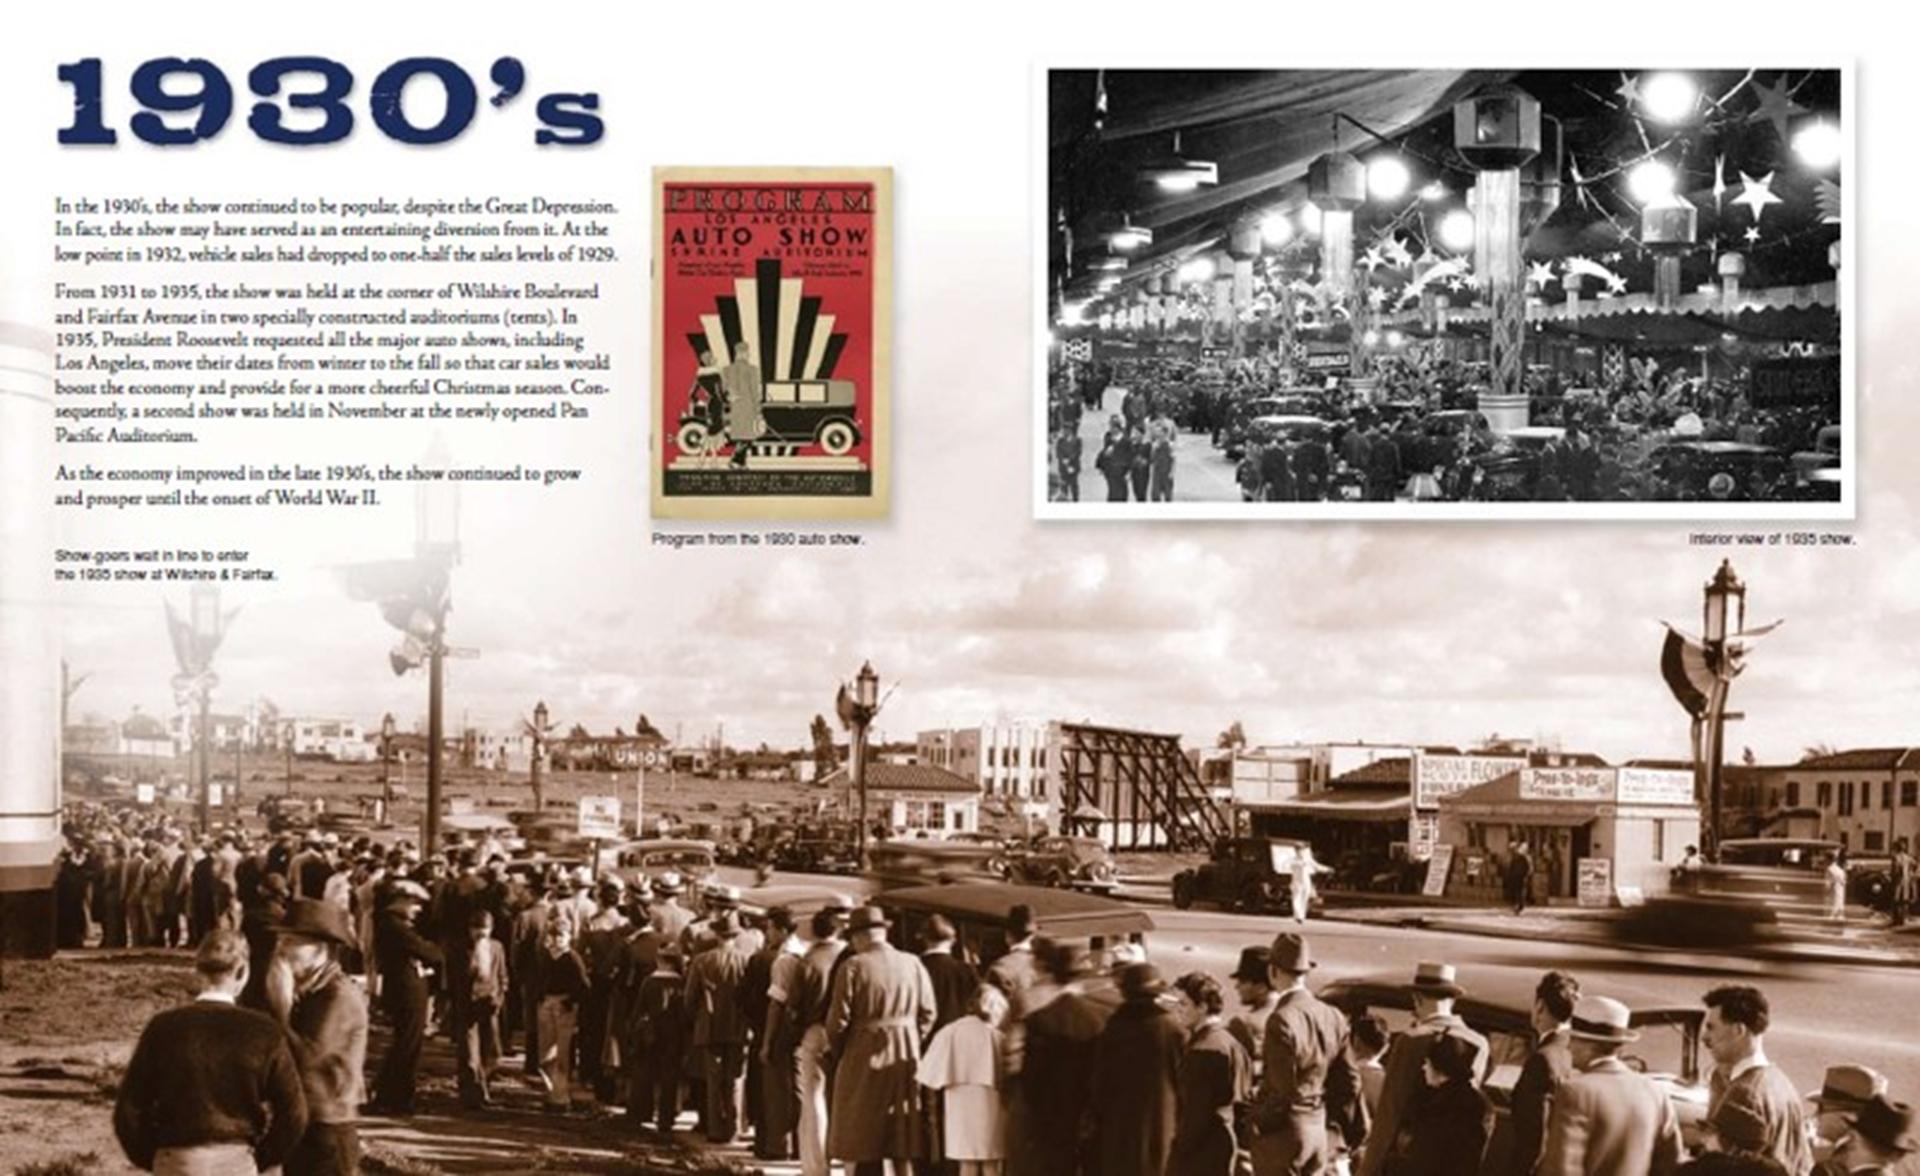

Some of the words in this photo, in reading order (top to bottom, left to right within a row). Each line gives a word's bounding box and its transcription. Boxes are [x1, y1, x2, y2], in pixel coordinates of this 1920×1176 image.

[670, 189, 870, 213] PROGRAM
[704, 212, 737, 225] LOS
[750, 212, 832, 225] ANGELES
[671, 226, 753, 246] AUTO
[778, 226, 867, 246] SHOW
[670, 247, 741, 257] SHRINE
[762, 247, 869, 258] AUDITORIUM
[615, 749, 668, 766] UNION
